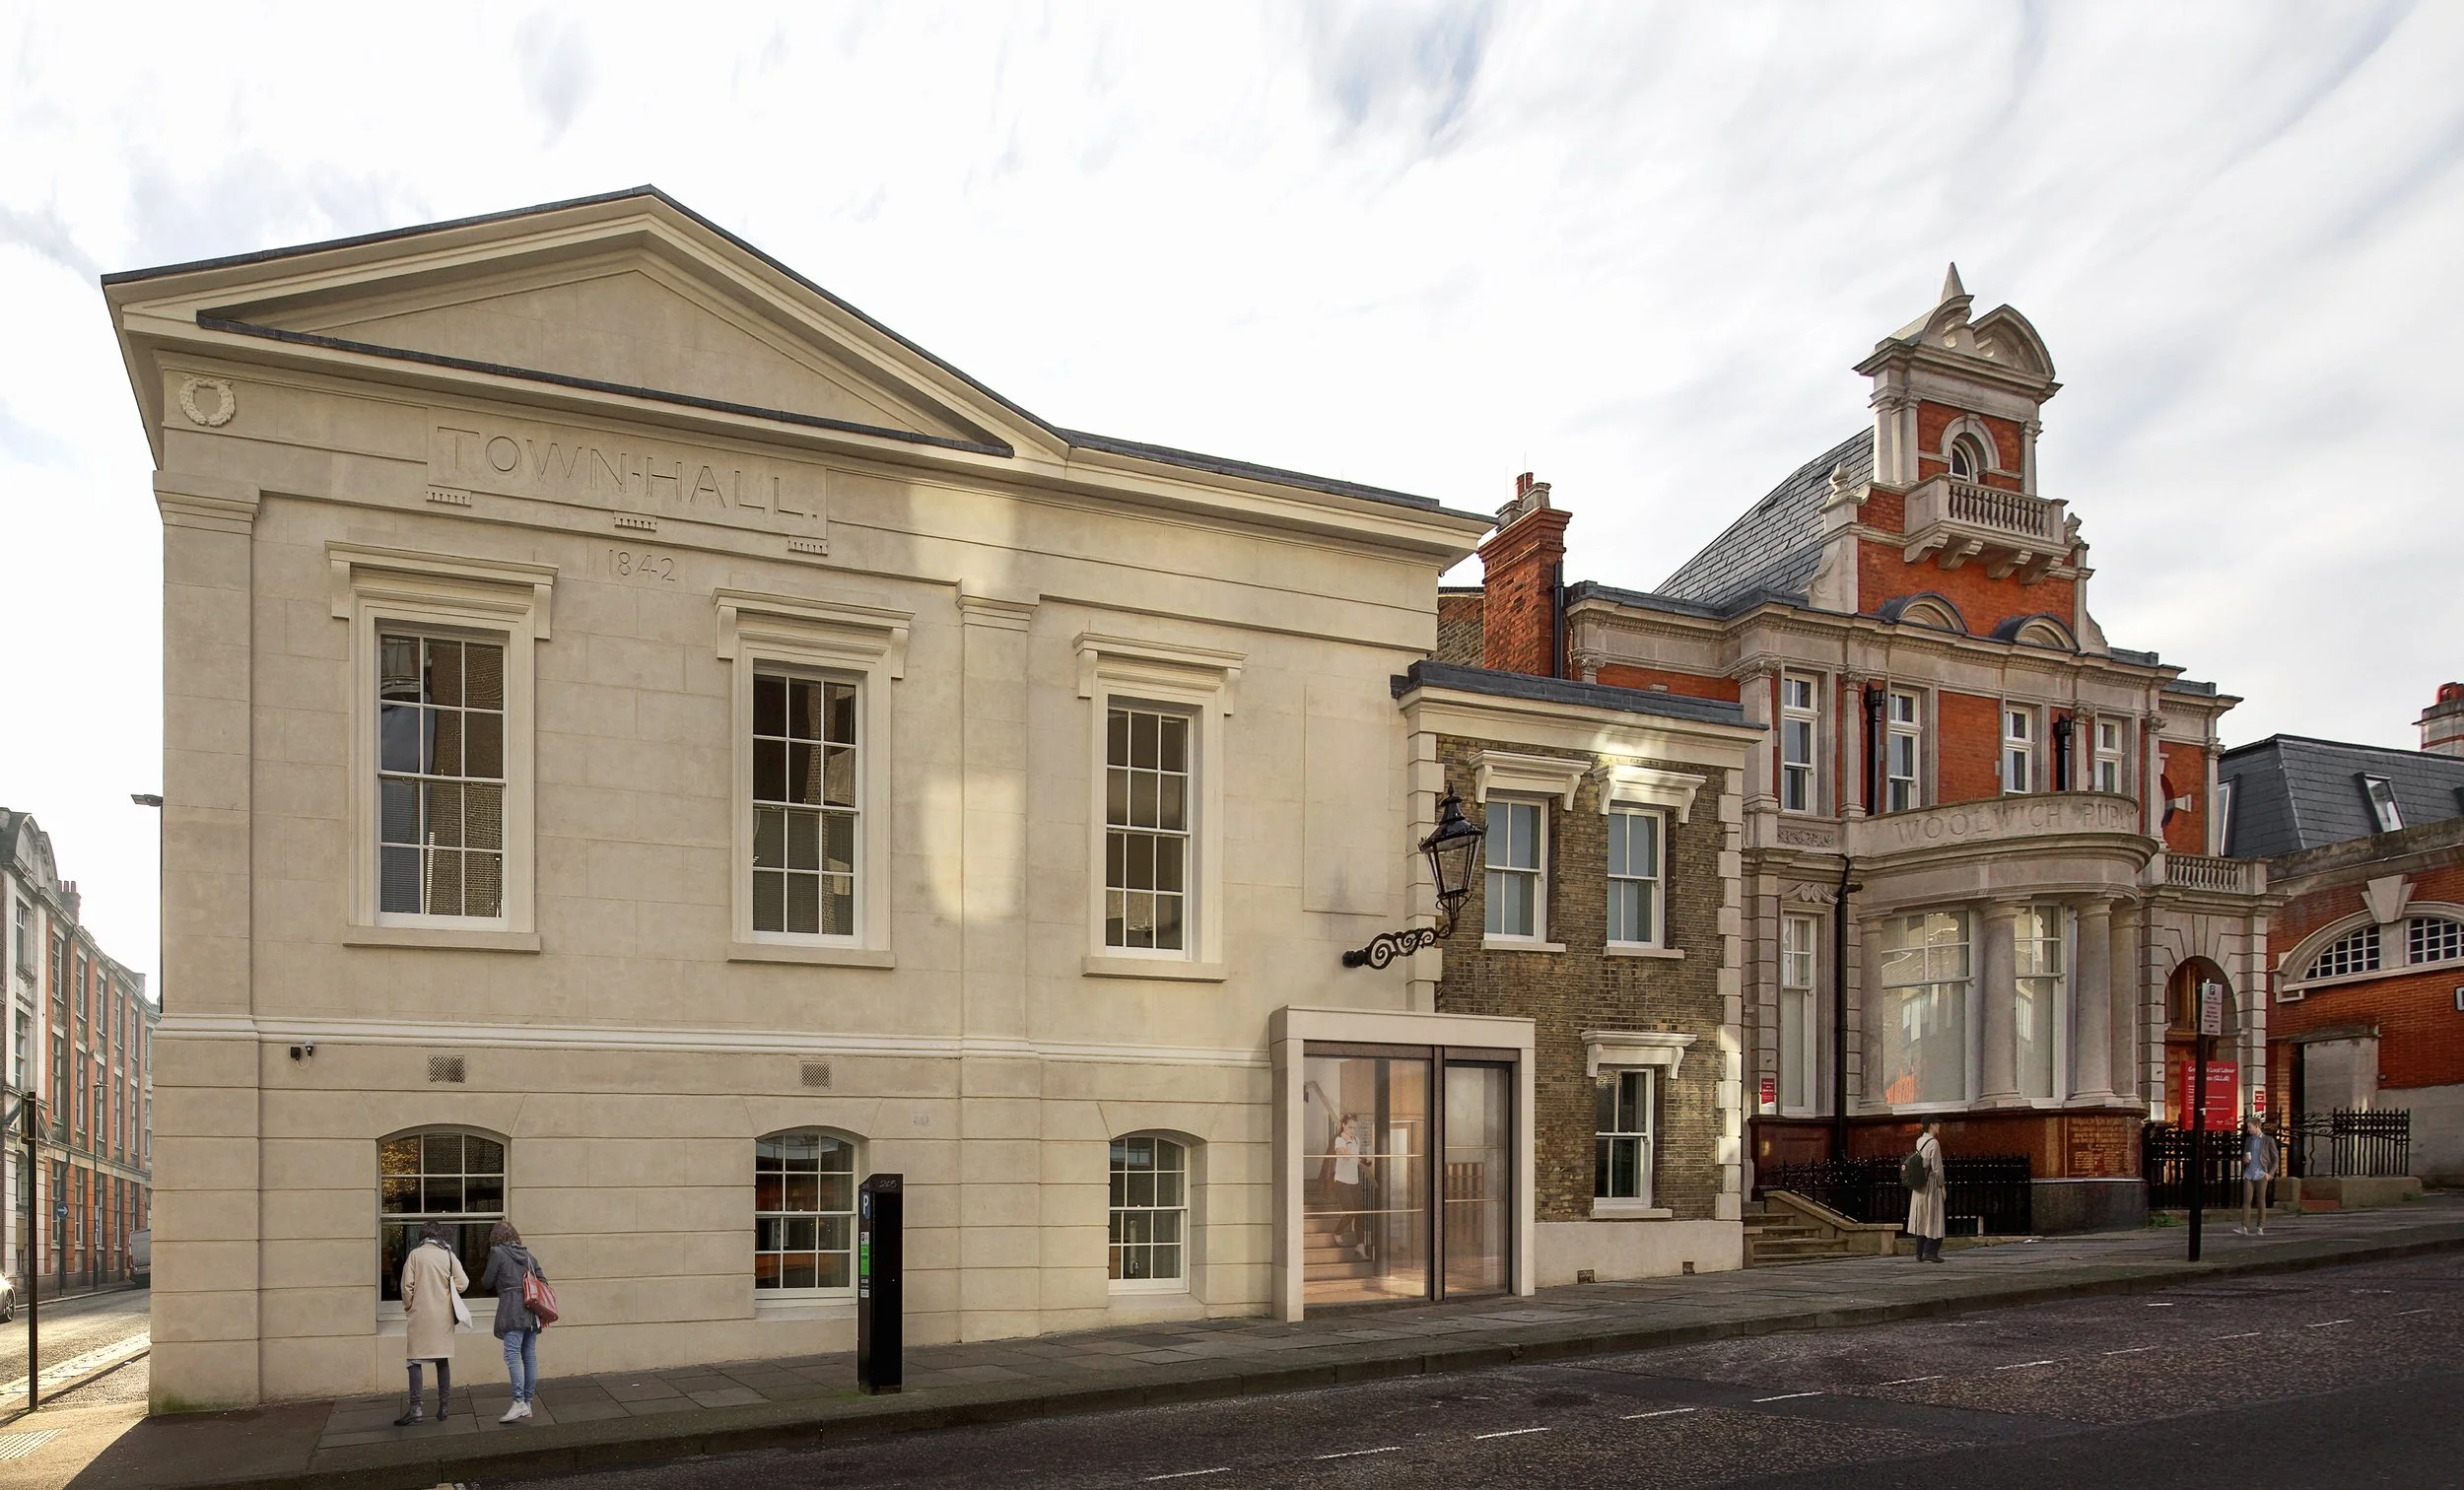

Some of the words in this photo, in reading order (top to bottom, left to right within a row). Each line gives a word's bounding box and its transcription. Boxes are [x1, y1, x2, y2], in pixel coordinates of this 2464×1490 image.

[608, 549, 676, 582] 1842
[1895, 802, 2062, 845] WOOLWICH
[862, 1194, 869, 1215] P
